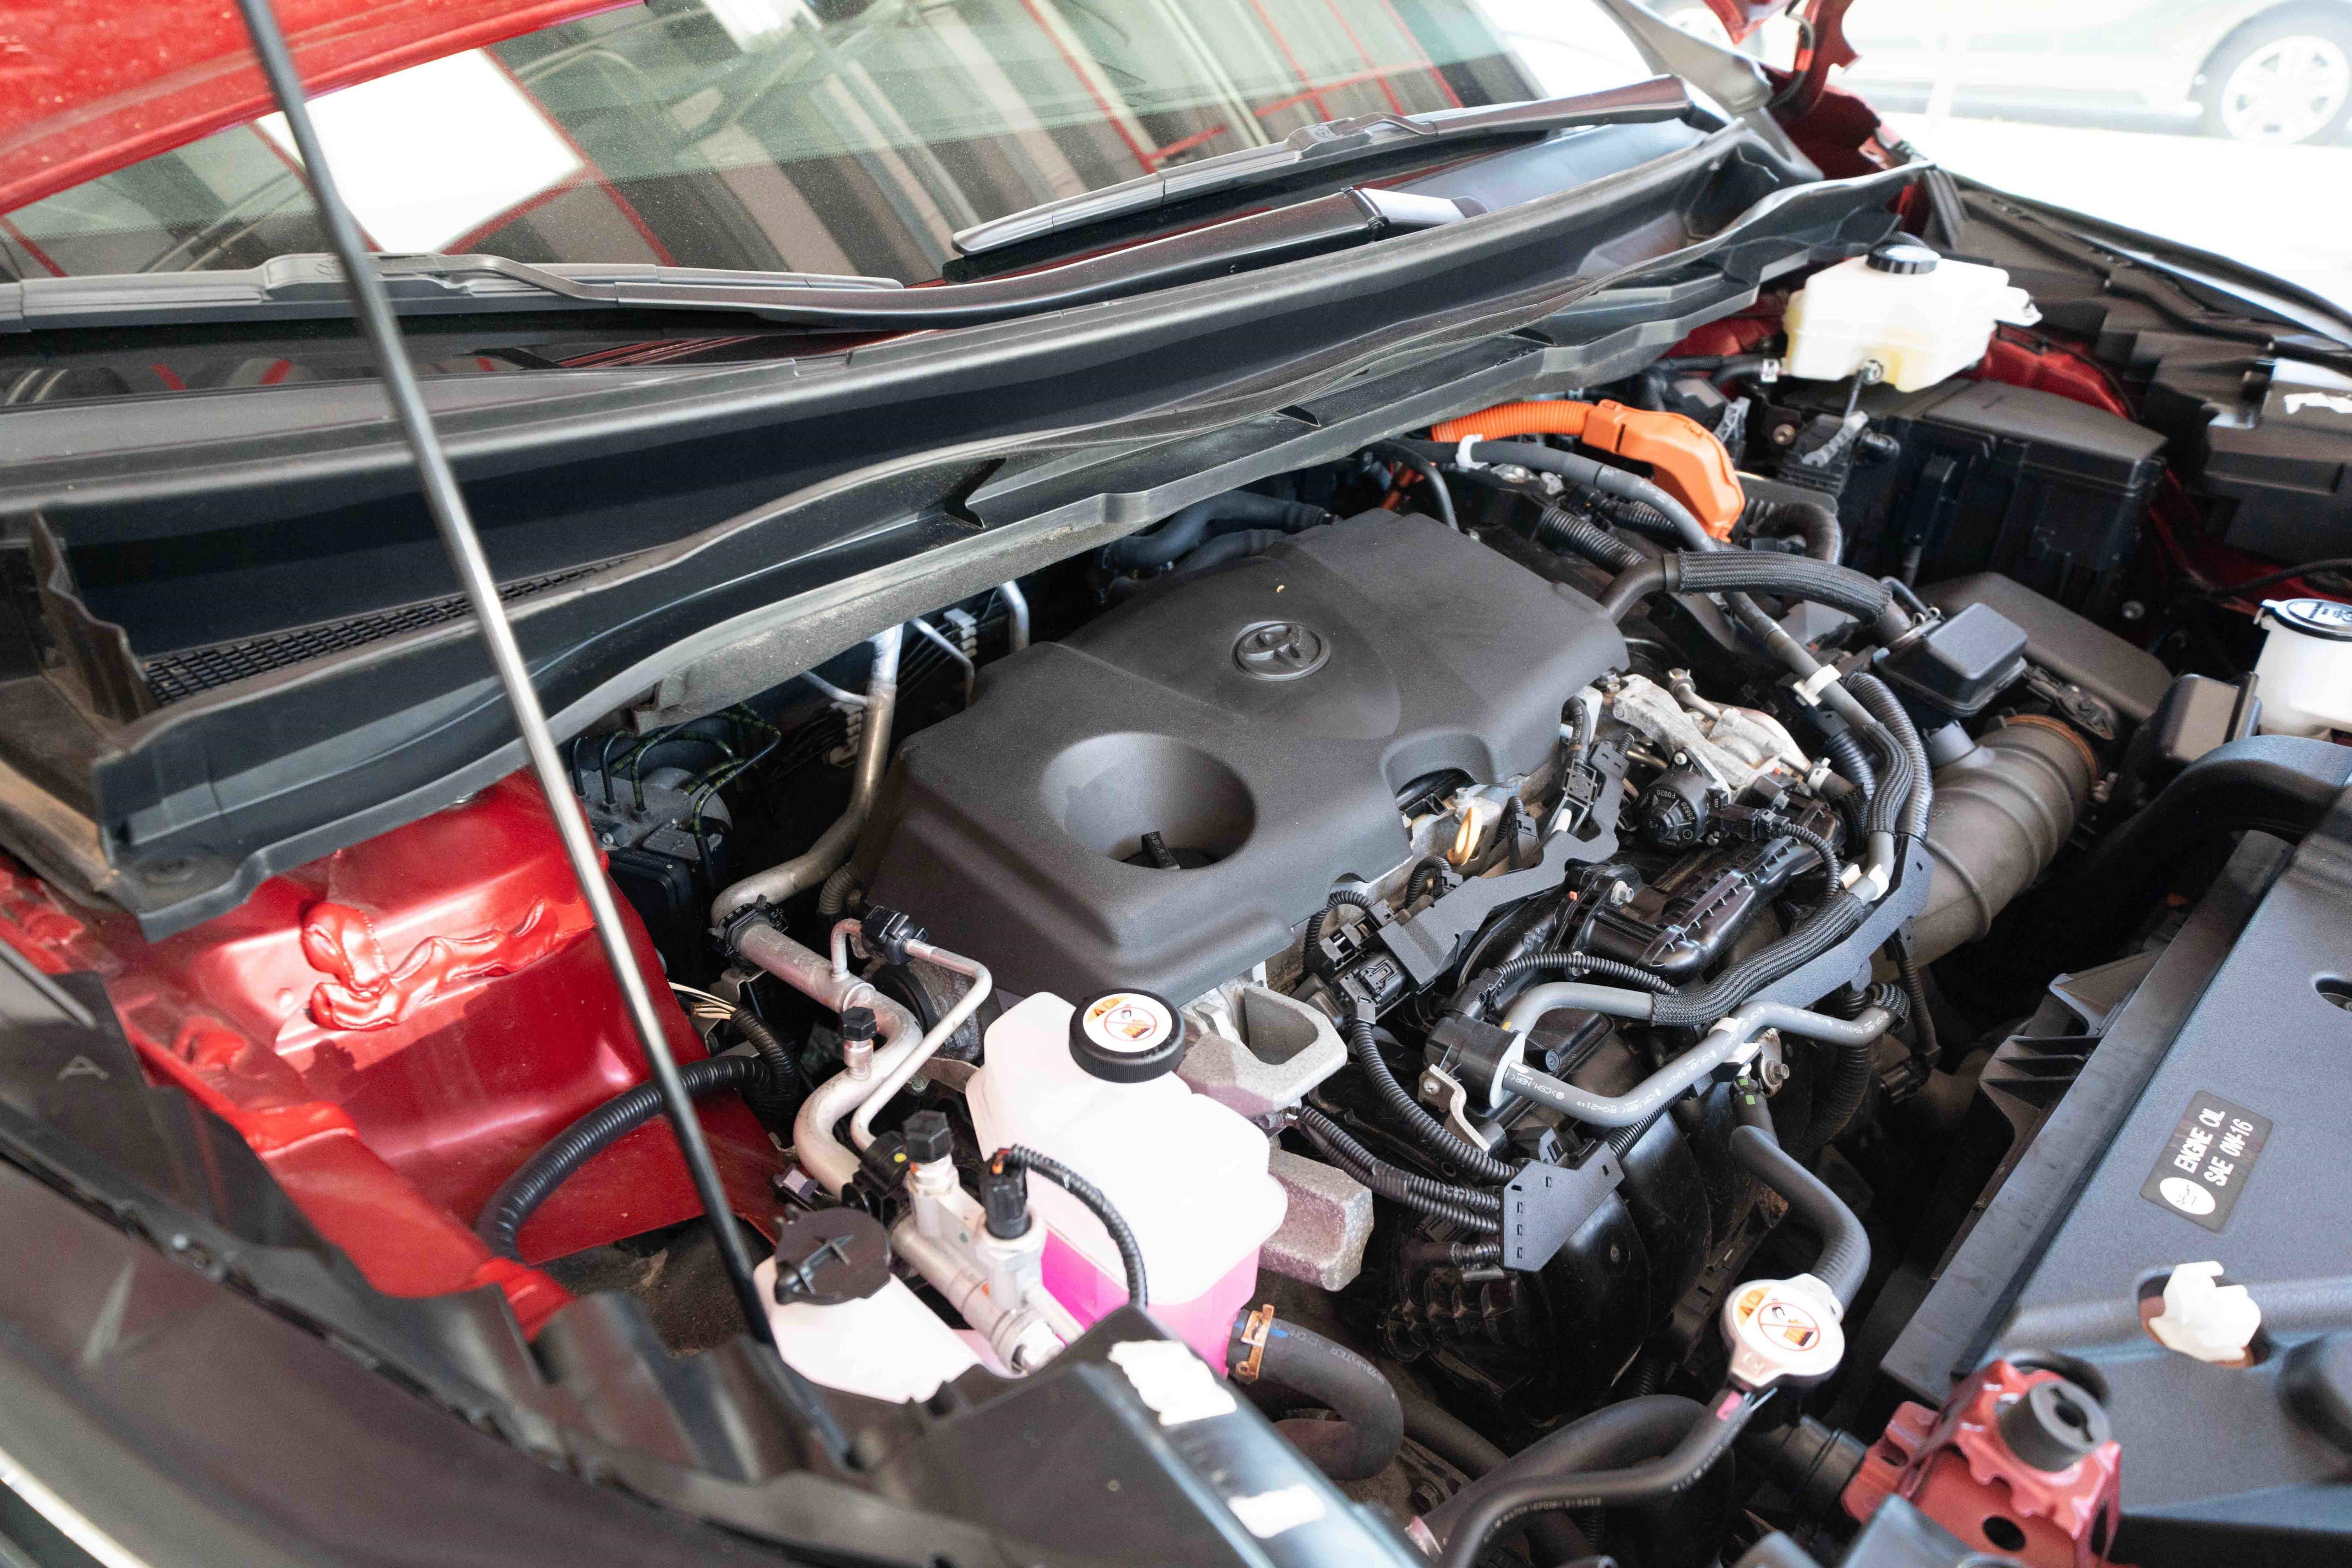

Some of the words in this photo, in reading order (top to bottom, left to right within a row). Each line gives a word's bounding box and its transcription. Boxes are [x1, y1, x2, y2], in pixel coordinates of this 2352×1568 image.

[1656, 789, 1676, 799] F0020
[2174, 1127, 2213, 1174] ENGINE
[2204, 1156, 2234, 1186] SAE
